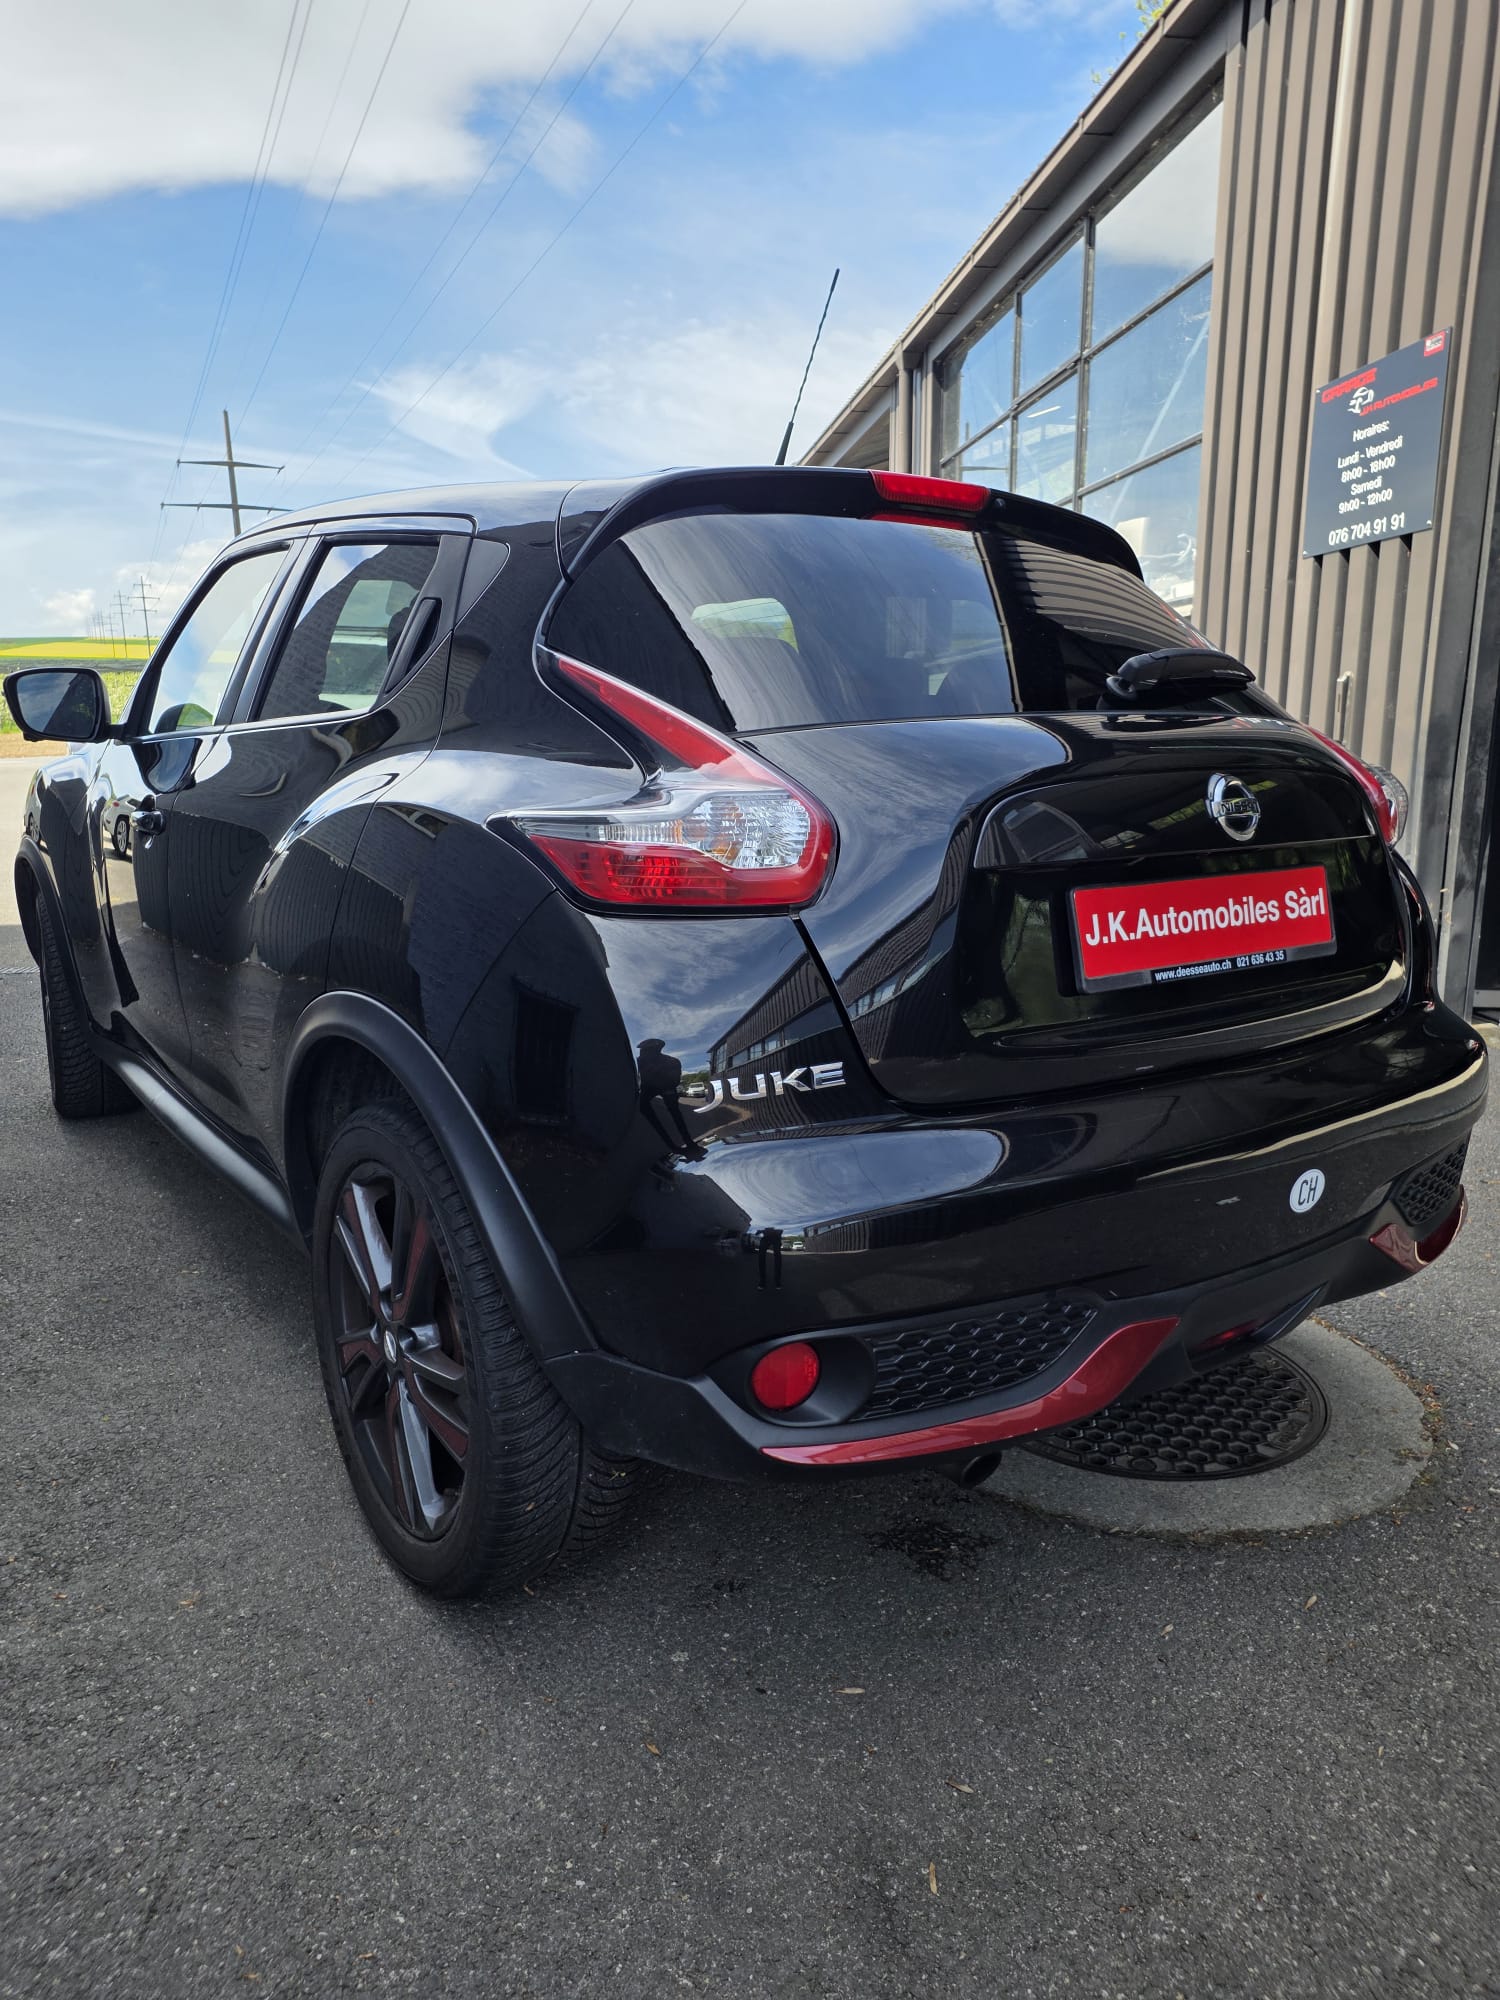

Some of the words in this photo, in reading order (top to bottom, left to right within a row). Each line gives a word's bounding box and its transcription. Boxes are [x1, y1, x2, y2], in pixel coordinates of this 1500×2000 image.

[1353, 420, 1390, 442] Horaires:
[1337, 450, 1360, 469] Lundi
[1365, 434, 1403, 458] Vendredi
[1341, 466, 1362, 483] 8h00
[1370, 454, 1396, 473] 18h00
[1351, 475, 1382, 495] Samedi
[1338, 498, 1360, 514] 9h00
[1367, 488, 1393, 505] 12h00
[1328, 527, 1349, 546] 076
[1350, 520, 1371, 540] 704
[1373, 516, 1387, 535] 91
[1390, 511, 1405, 530] 91
[1085, 895, 1280, 946] J.K.Automobiles
[1284, 887, 1326, 919] Sàrl
[1154, 959, 1232, 981] www.deesseauto.ch
[1236, 957, 1250, 968] 021
[1265, 951, 1275, 962] 43
[1275, 950, 1285, 961] 35
[693, 1060, 847, 1114] JUKE
[1297, 1174, 1319, 1206] CH
